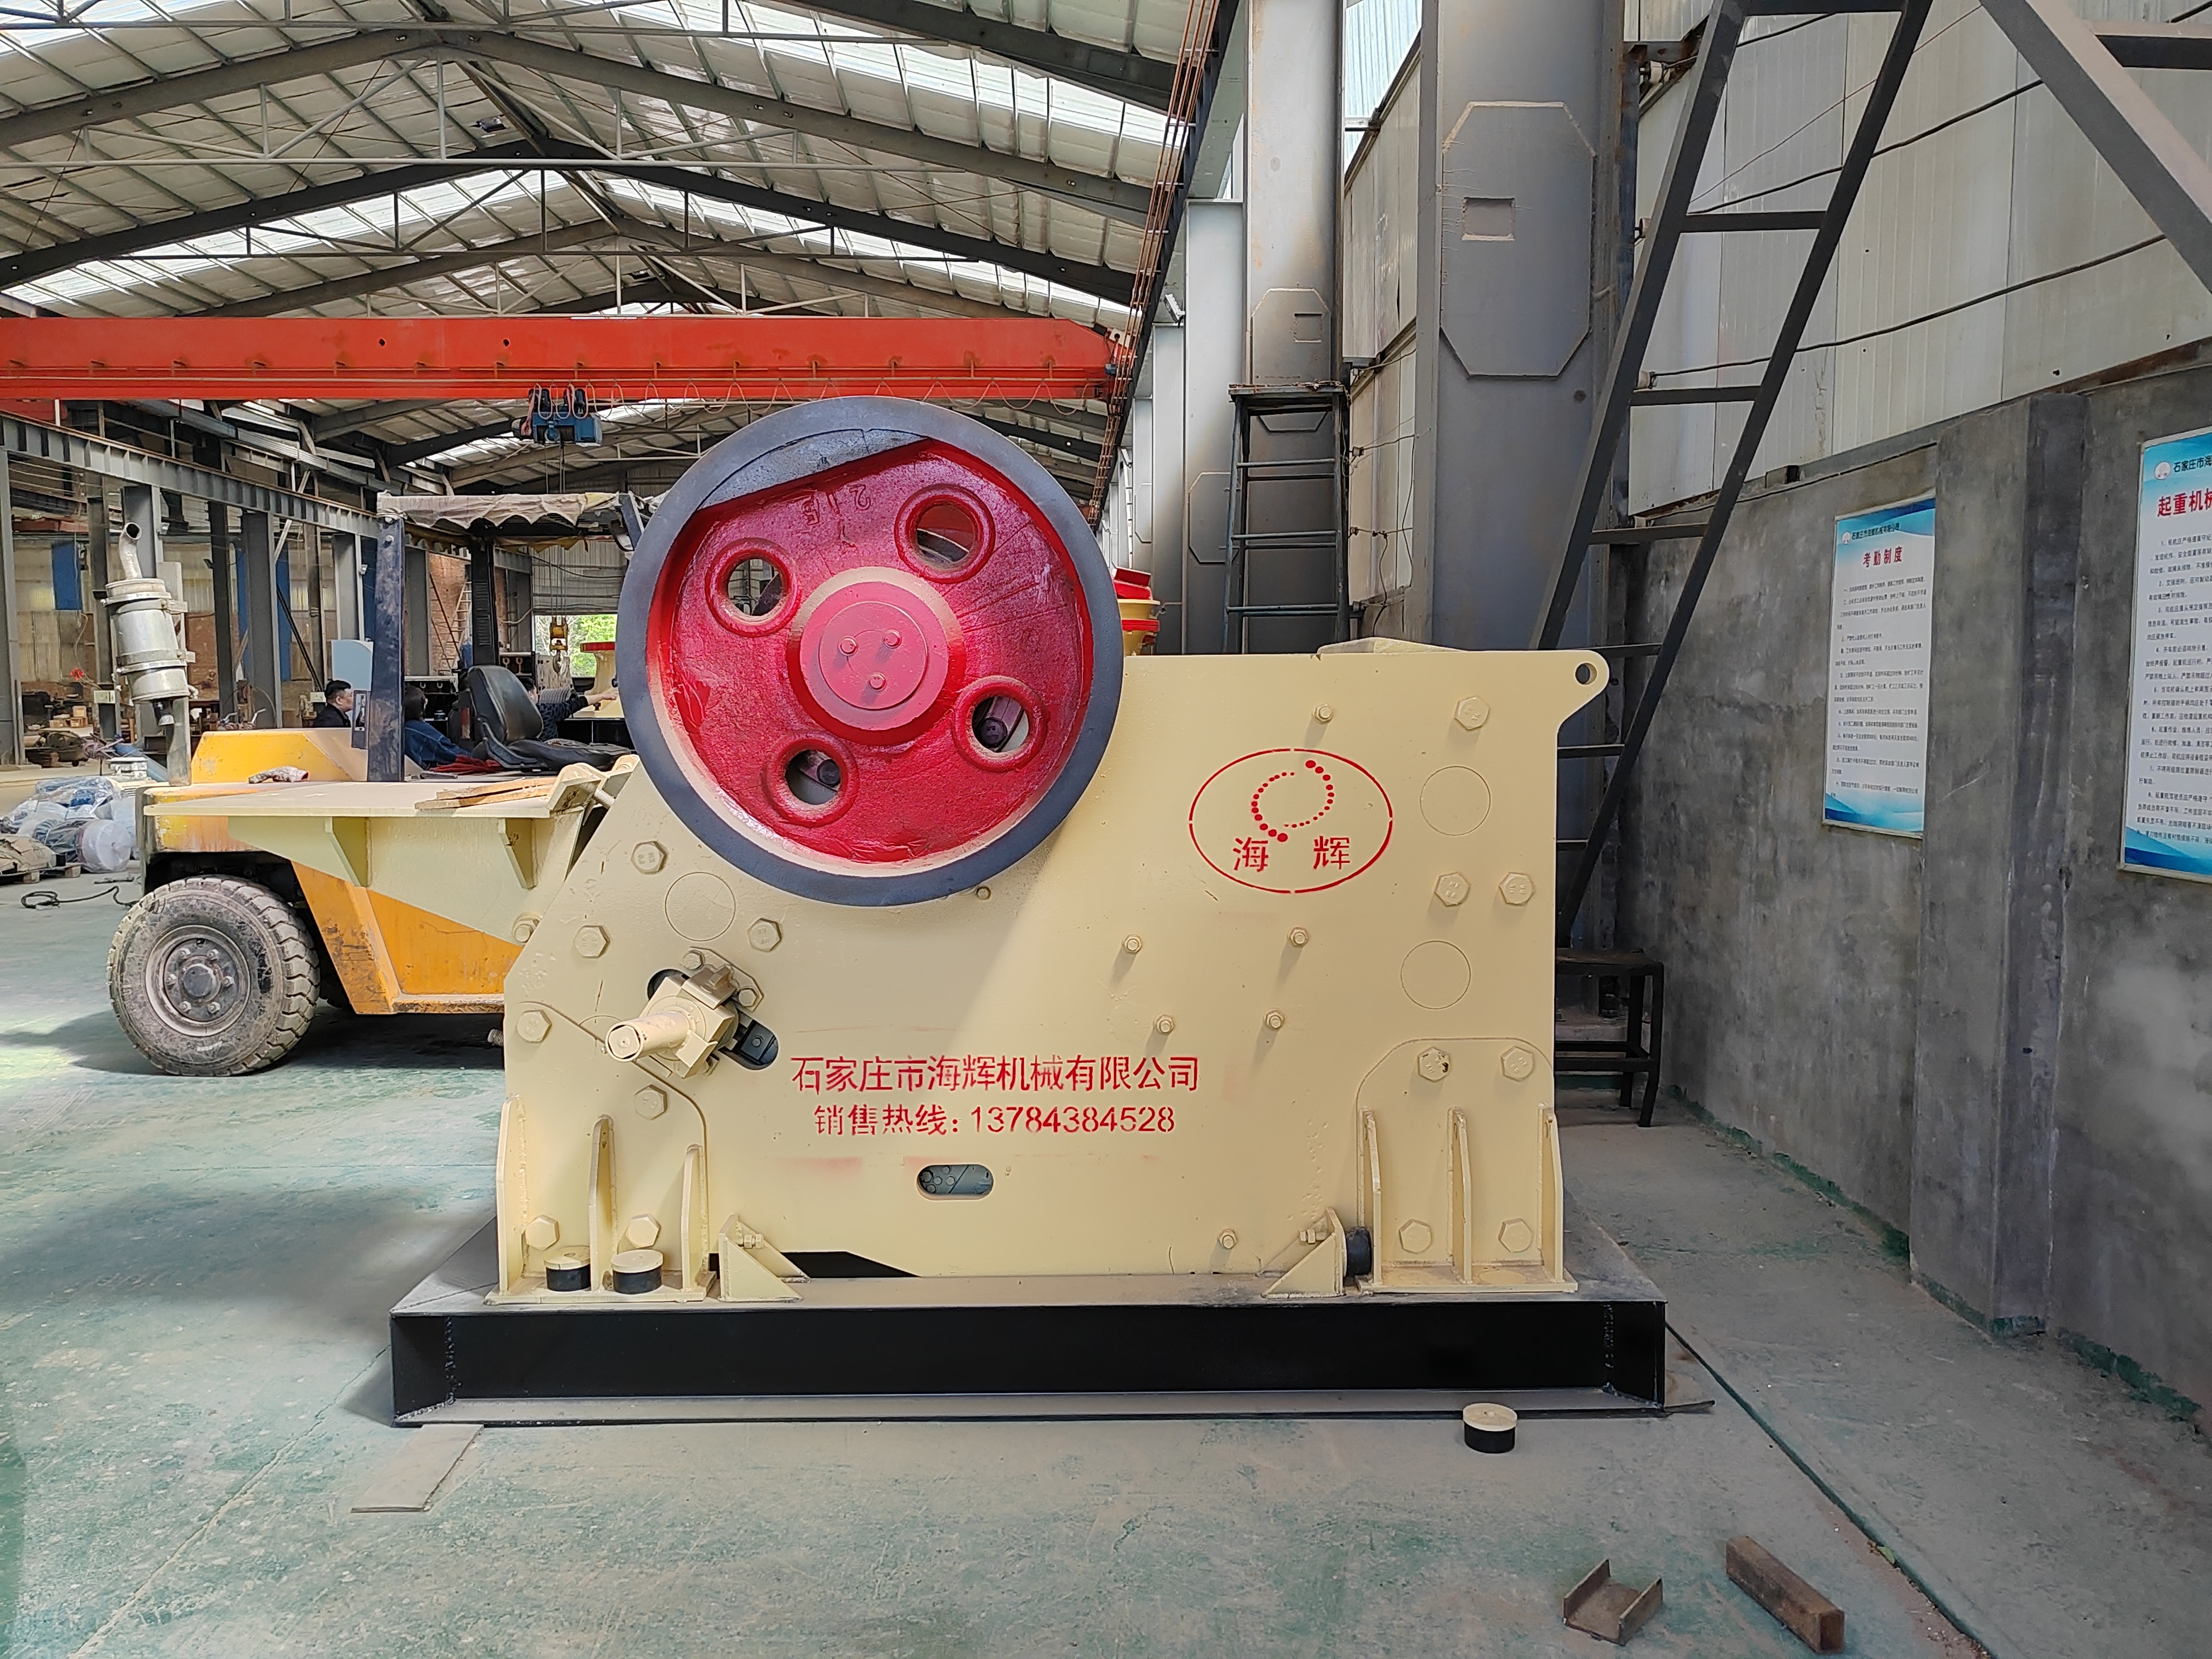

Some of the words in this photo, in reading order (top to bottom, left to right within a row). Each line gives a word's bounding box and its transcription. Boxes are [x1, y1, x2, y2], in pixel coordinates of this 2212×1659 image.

[2174, 456, 2212, 473] 石家庄市海
[1863, 545, 1903, 568] 考勤制度
[791, 1054, 1199, 1095] 石家庄市海辉机械有限公司
